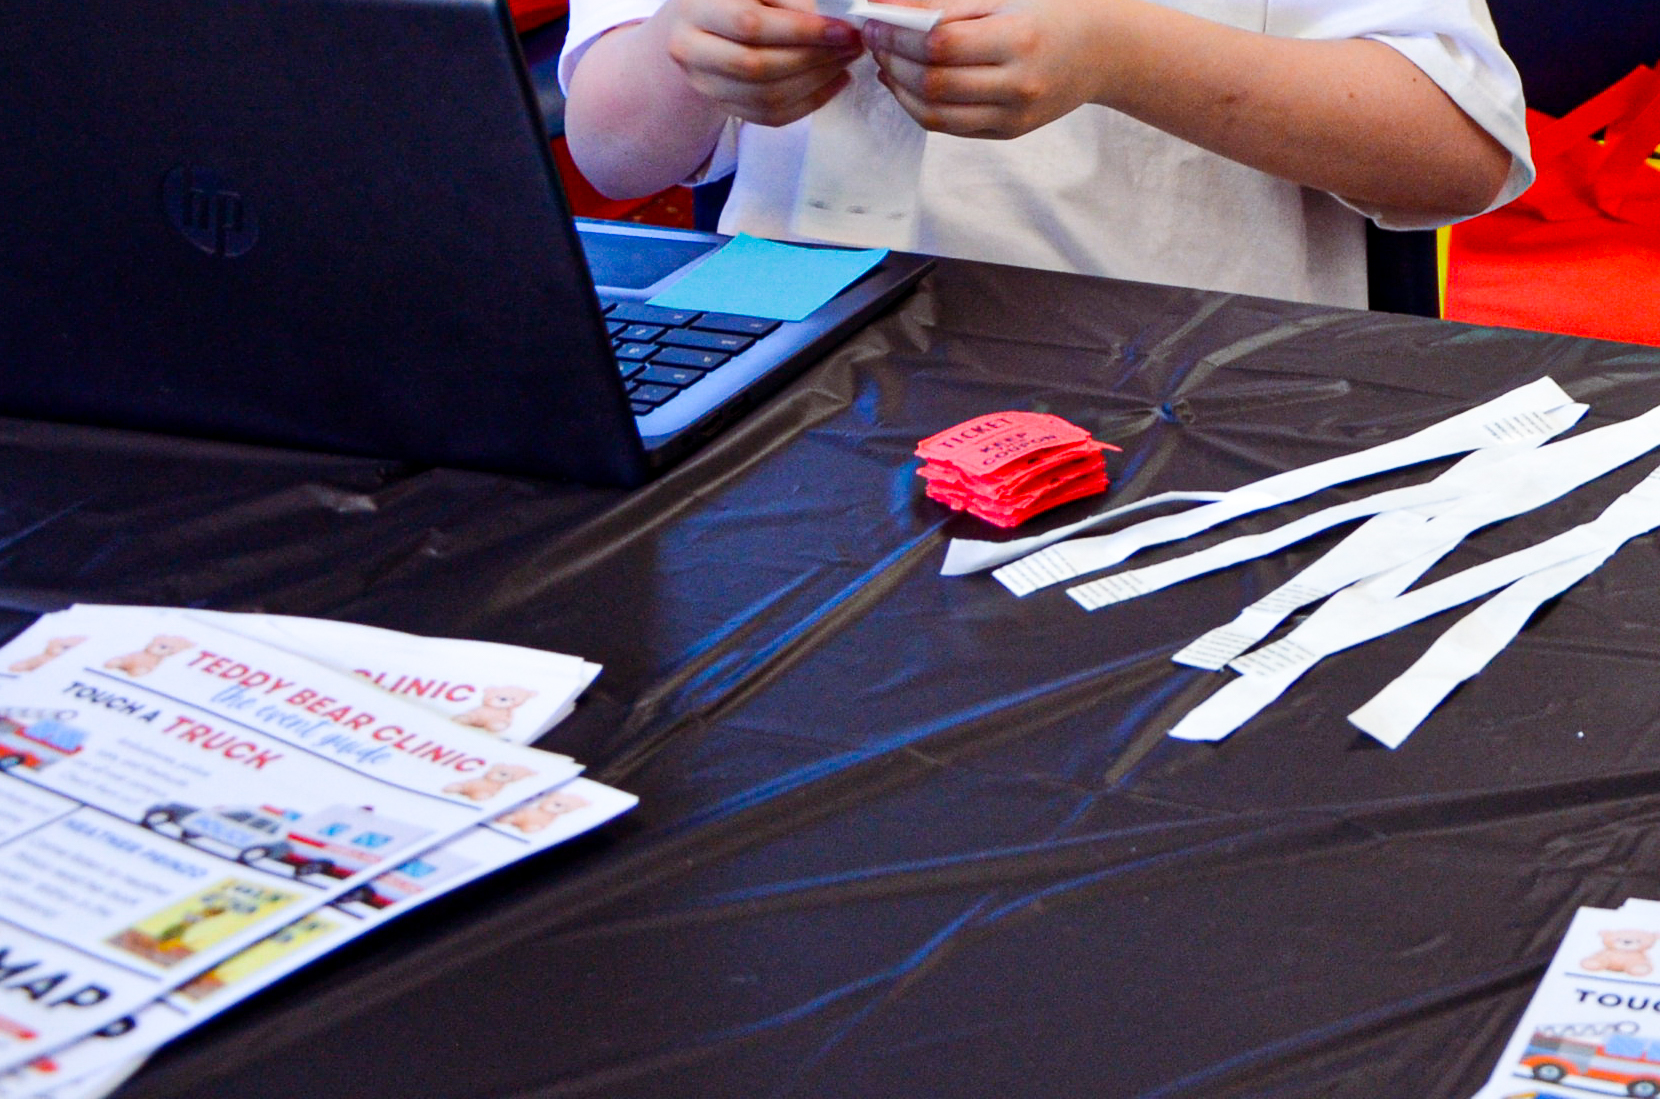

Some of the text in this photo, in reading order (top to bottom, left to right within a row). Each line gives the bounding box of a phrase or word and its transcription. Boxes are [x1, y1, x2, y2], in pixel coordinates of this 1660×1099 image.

[938, 417, 1013, 449] TICKET
[62, 681, 285, 770] TOUCH A TRUCK
[188, 650, 487, 772] TEDDY BEAR CLINIC
